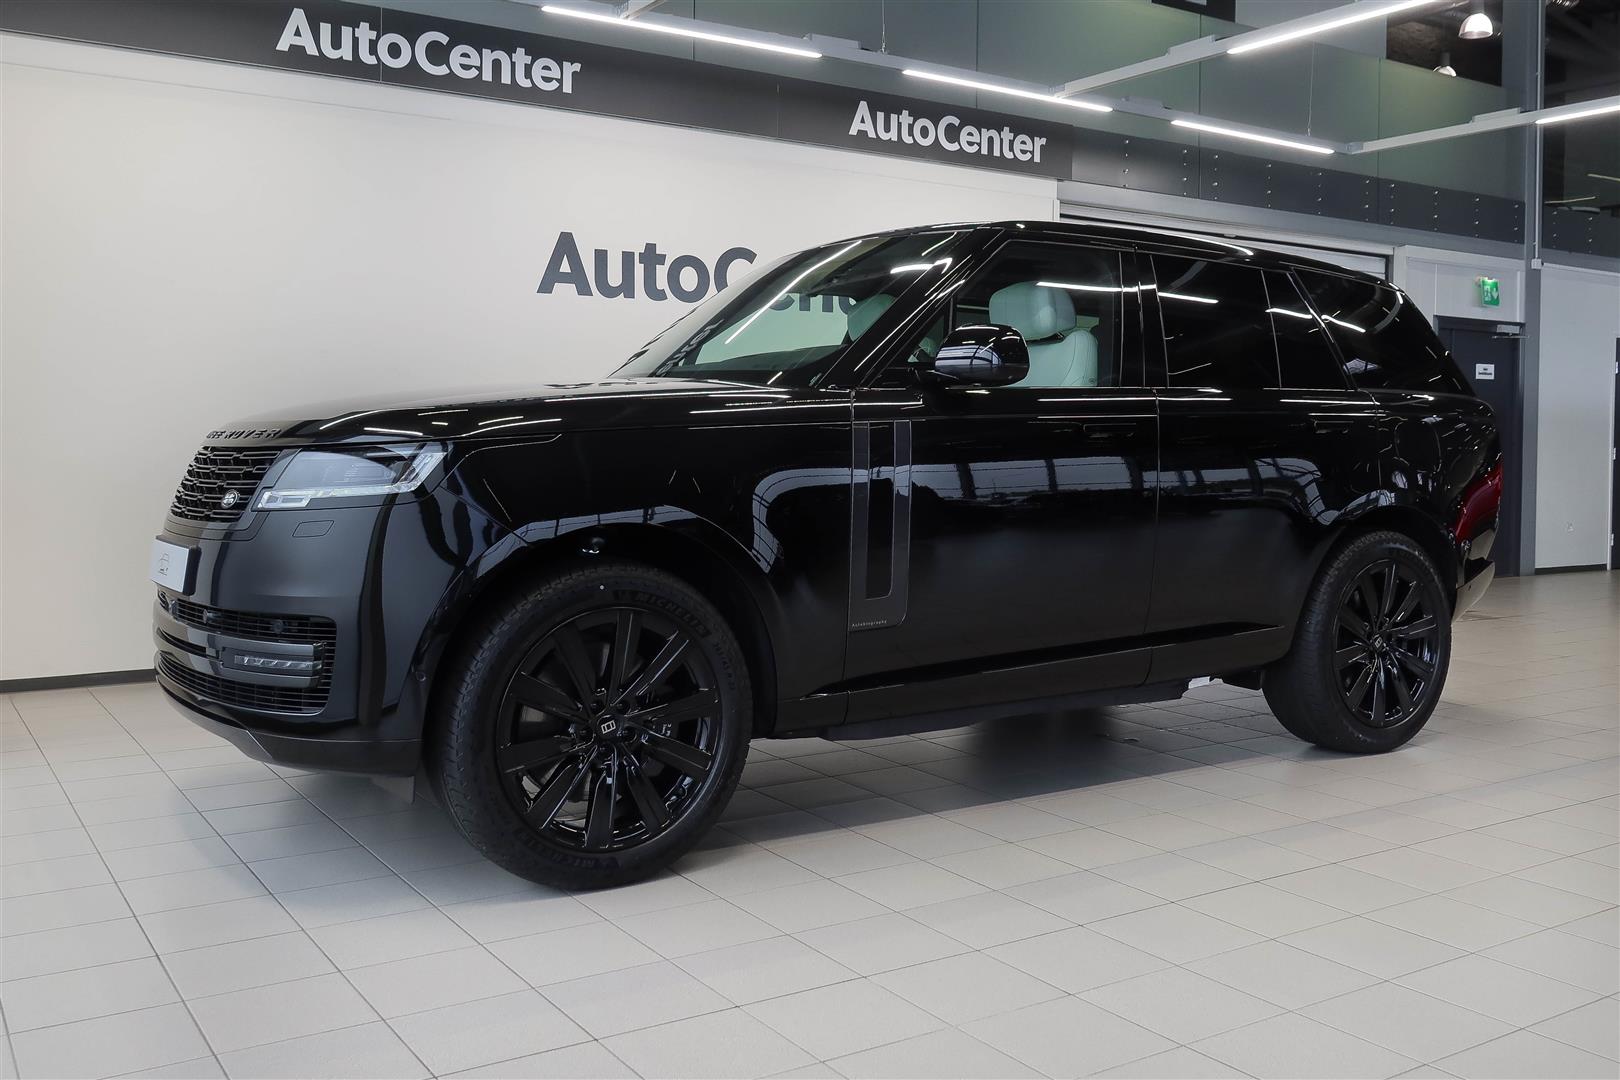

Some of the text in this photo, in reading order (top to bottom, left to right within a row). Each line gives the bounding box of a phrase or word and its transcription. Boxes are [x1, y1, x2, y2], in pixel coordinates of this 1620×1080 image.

[275, 7, 582, 94] AutoCenter
[848, 100, 1047, 163] AutoCenter
[536, 231, 857, 317] AutoC
